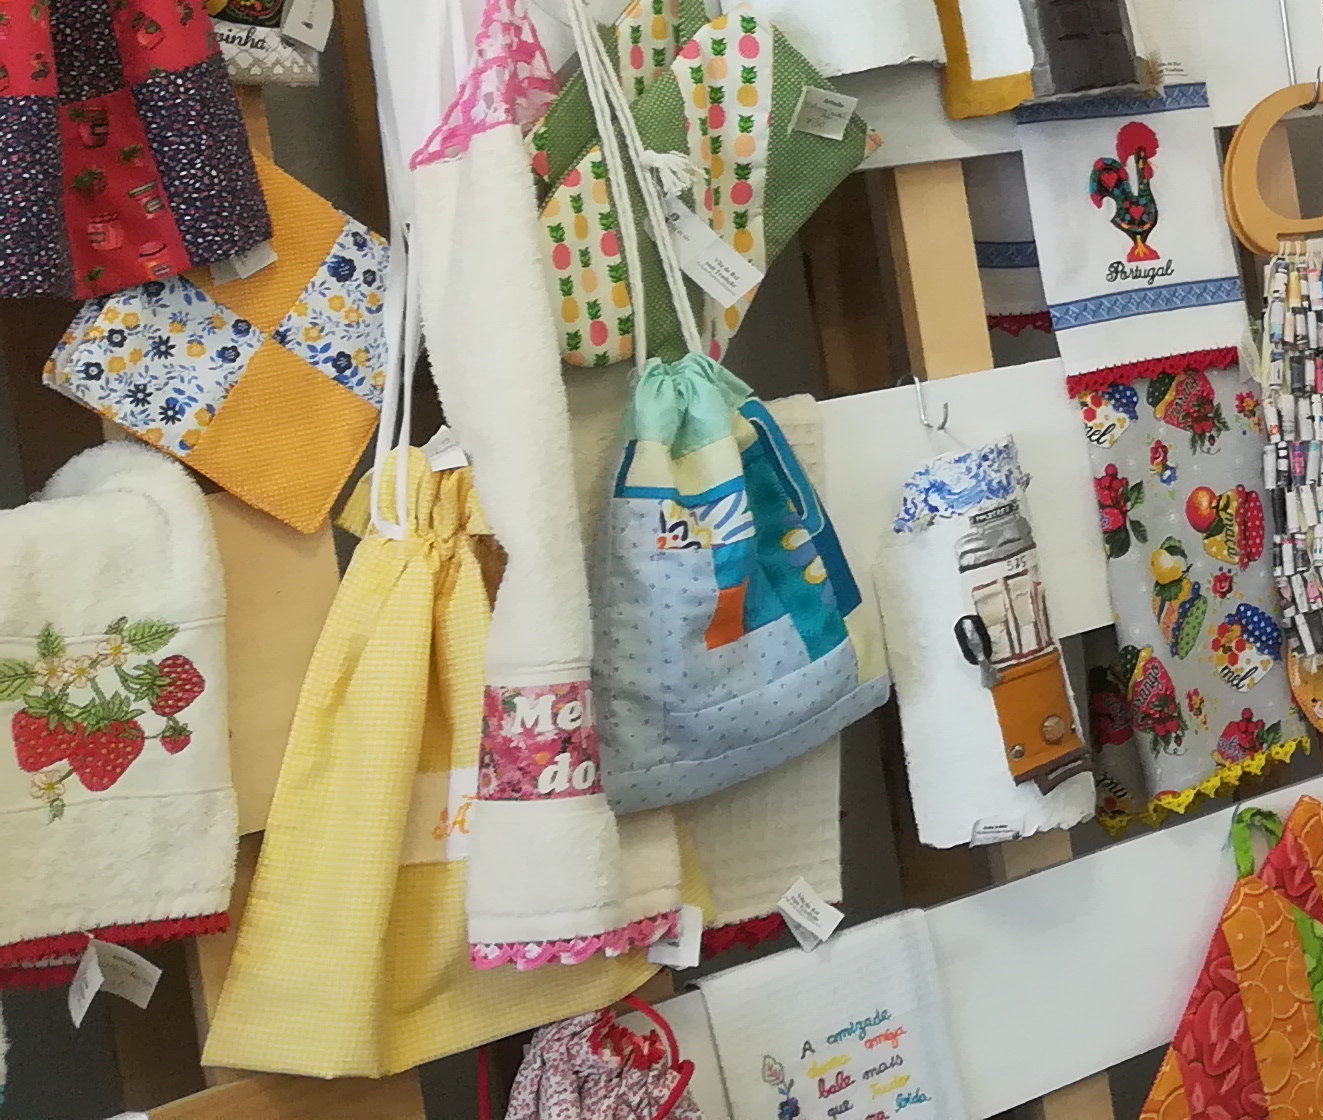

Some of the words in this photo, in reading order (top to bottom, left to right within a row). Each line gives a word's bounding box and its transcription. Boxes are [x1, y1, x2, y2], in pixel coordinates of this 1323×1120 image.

[1106, 259, 1175, 285] Portugal
[1219, 664, 1259, 691] mel
[536, 751, 598, 796] do
[800, 1040, 816, 1060] A
[826, 1008, 892, 1045] amizade
